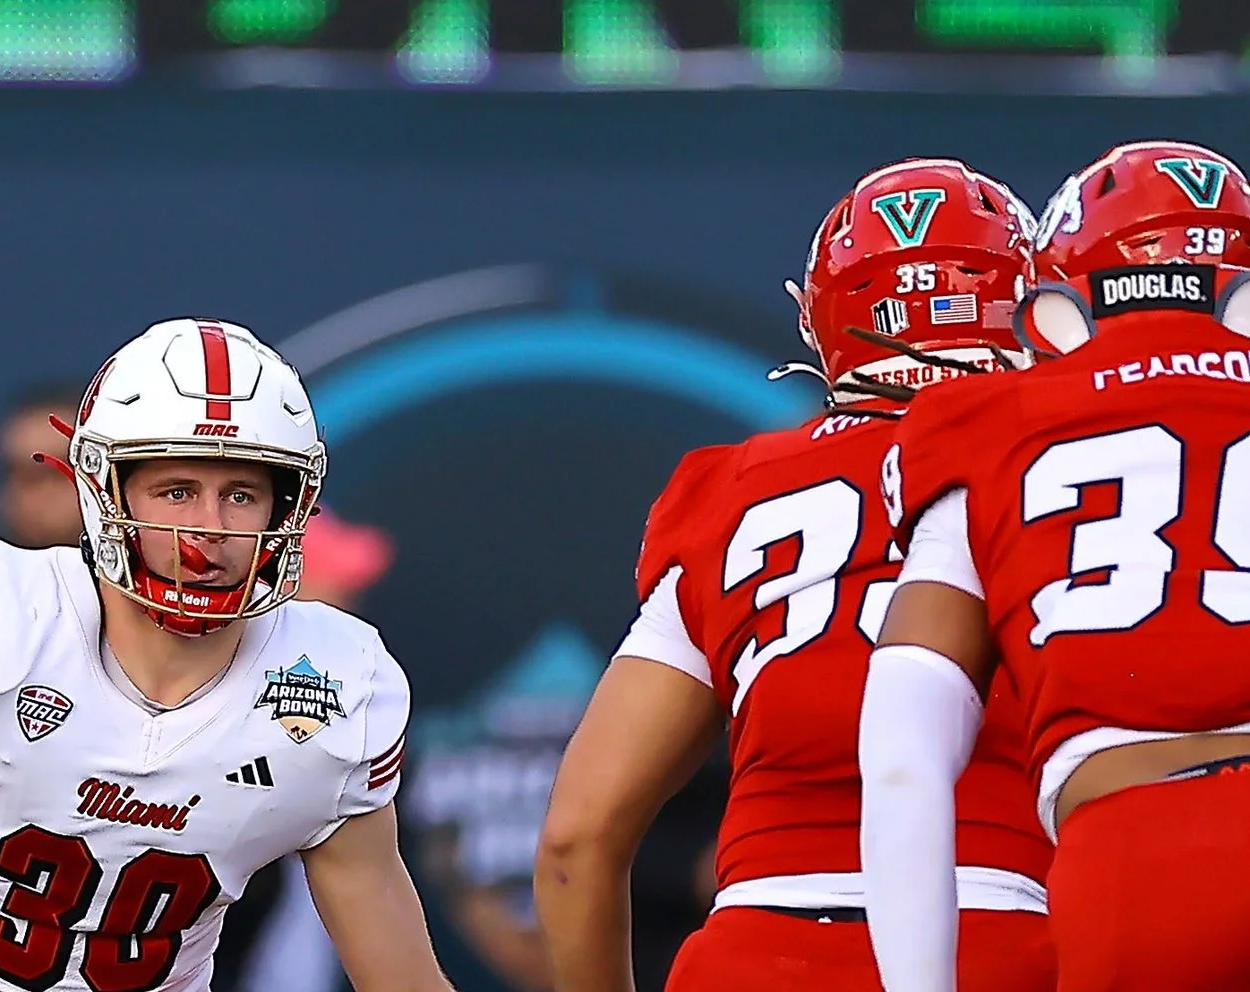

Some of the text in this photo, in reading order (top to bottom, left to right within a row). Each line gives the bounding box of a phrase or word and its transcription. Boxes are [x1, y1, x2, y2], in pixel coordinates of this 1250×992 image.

[1155, 158, 1228, 209] V
[872, 188, 945, 247] V
[1184, 227, 1225, 255] 39
[895, 263, 936, 294] 35
[193, 424, 238, 438] MAC
[267, 684, 337, 706] ARIZONA
[279, 699, 325, 717] BOWL
[18, 700, 68, 724] MAC
[76, 777, 202, 832] Miami
